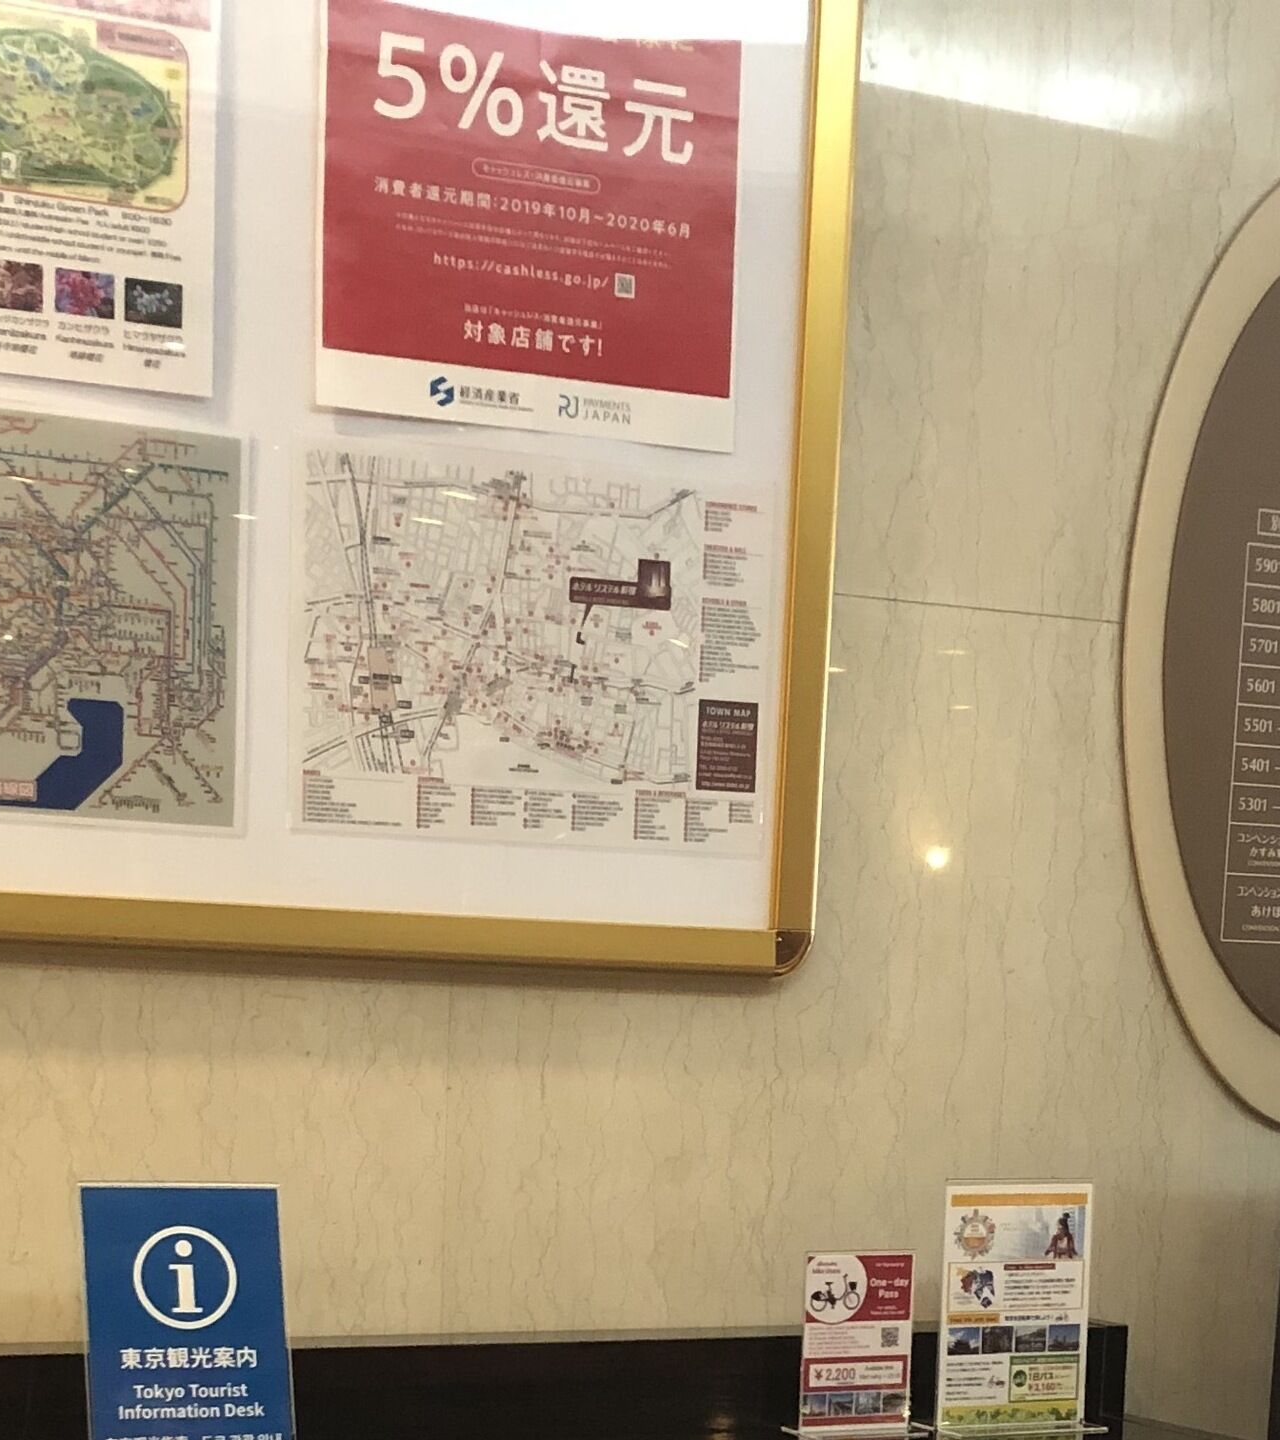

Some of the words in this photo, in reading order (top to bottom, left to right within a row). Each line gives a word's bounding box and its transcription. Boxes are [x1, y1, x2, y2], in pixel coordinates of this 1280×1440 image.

[373, 30, 695, 165] 5%還元
[433, 252, 609, 289] https://cashless.go.jp/
[463, 320, 603, 357] 対象店舗です!
[583, 410, 631, 425] JAPAN
[1252, 597, 1280, 615] 5801
[1249, 637, 1278, 654] 5701
[1247, 678, 1276, 695] 5601
[706, 706, 731, 717] TOWN
[1244, 717, 1273, 734] 5501
[1241, 757, 1270, 773] 5401
[1238, 796, 1268, 812] 5301
[119, 1347, 258, 1370] 東京観光案内
[133, 1385, 184, 1401] Tokyo
[190, 1383, 249, 1398] Tourist
[118, 1404, 220, 1420] Information
[224, 1402, 265, 1417] Desk
